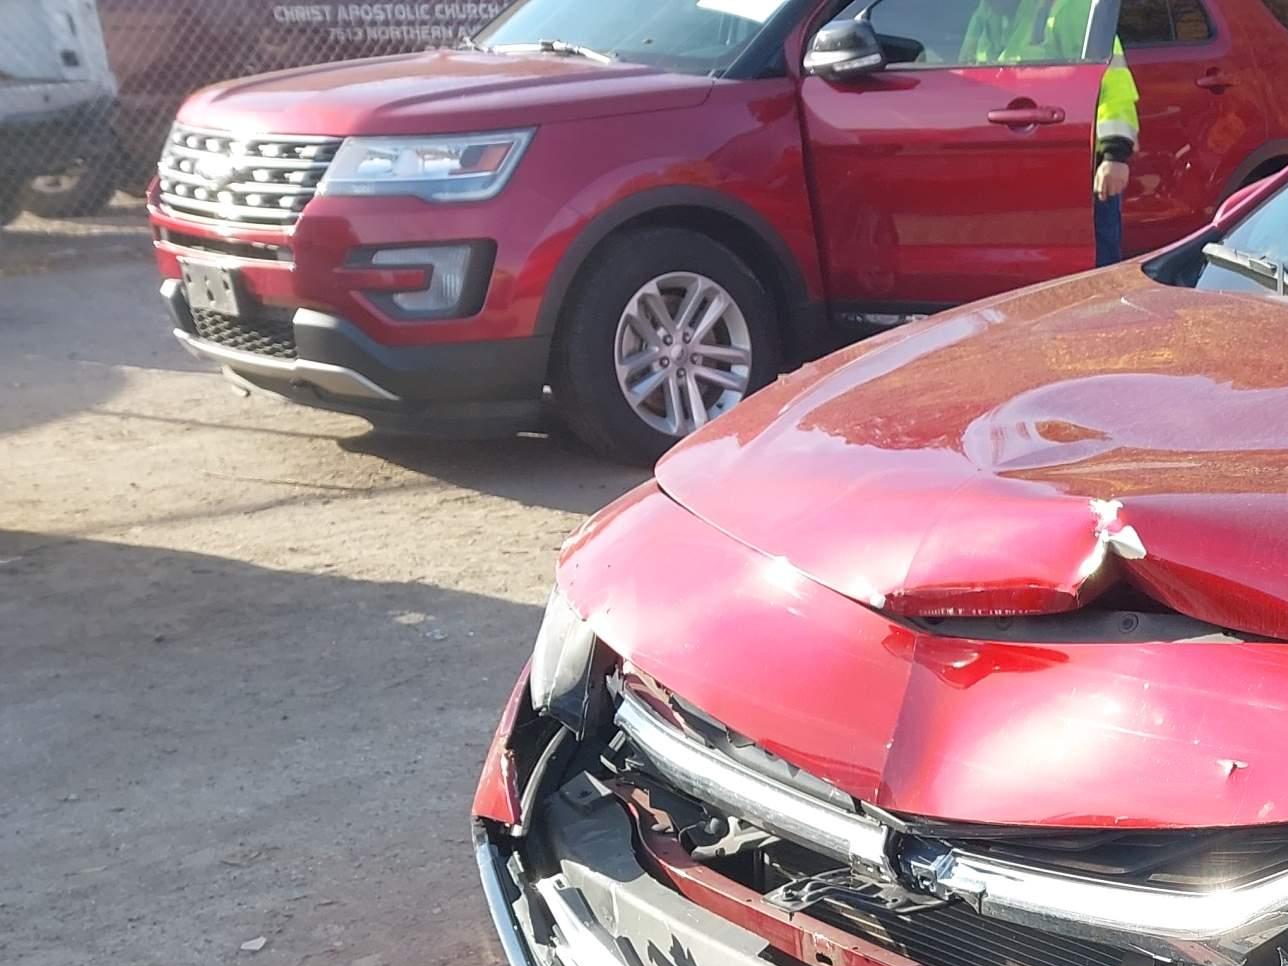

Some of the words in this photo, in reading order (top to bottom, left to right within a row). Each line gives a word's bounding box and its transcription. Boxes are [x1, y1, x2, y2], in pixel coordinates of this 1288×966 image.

[273, 5, 332, 22] CHRIST
[337, 3, 430, 22] APOSTOLIC
[434, 3, 499, 20] CHURCH
[366, 25, 453, 41] NORTHERN
